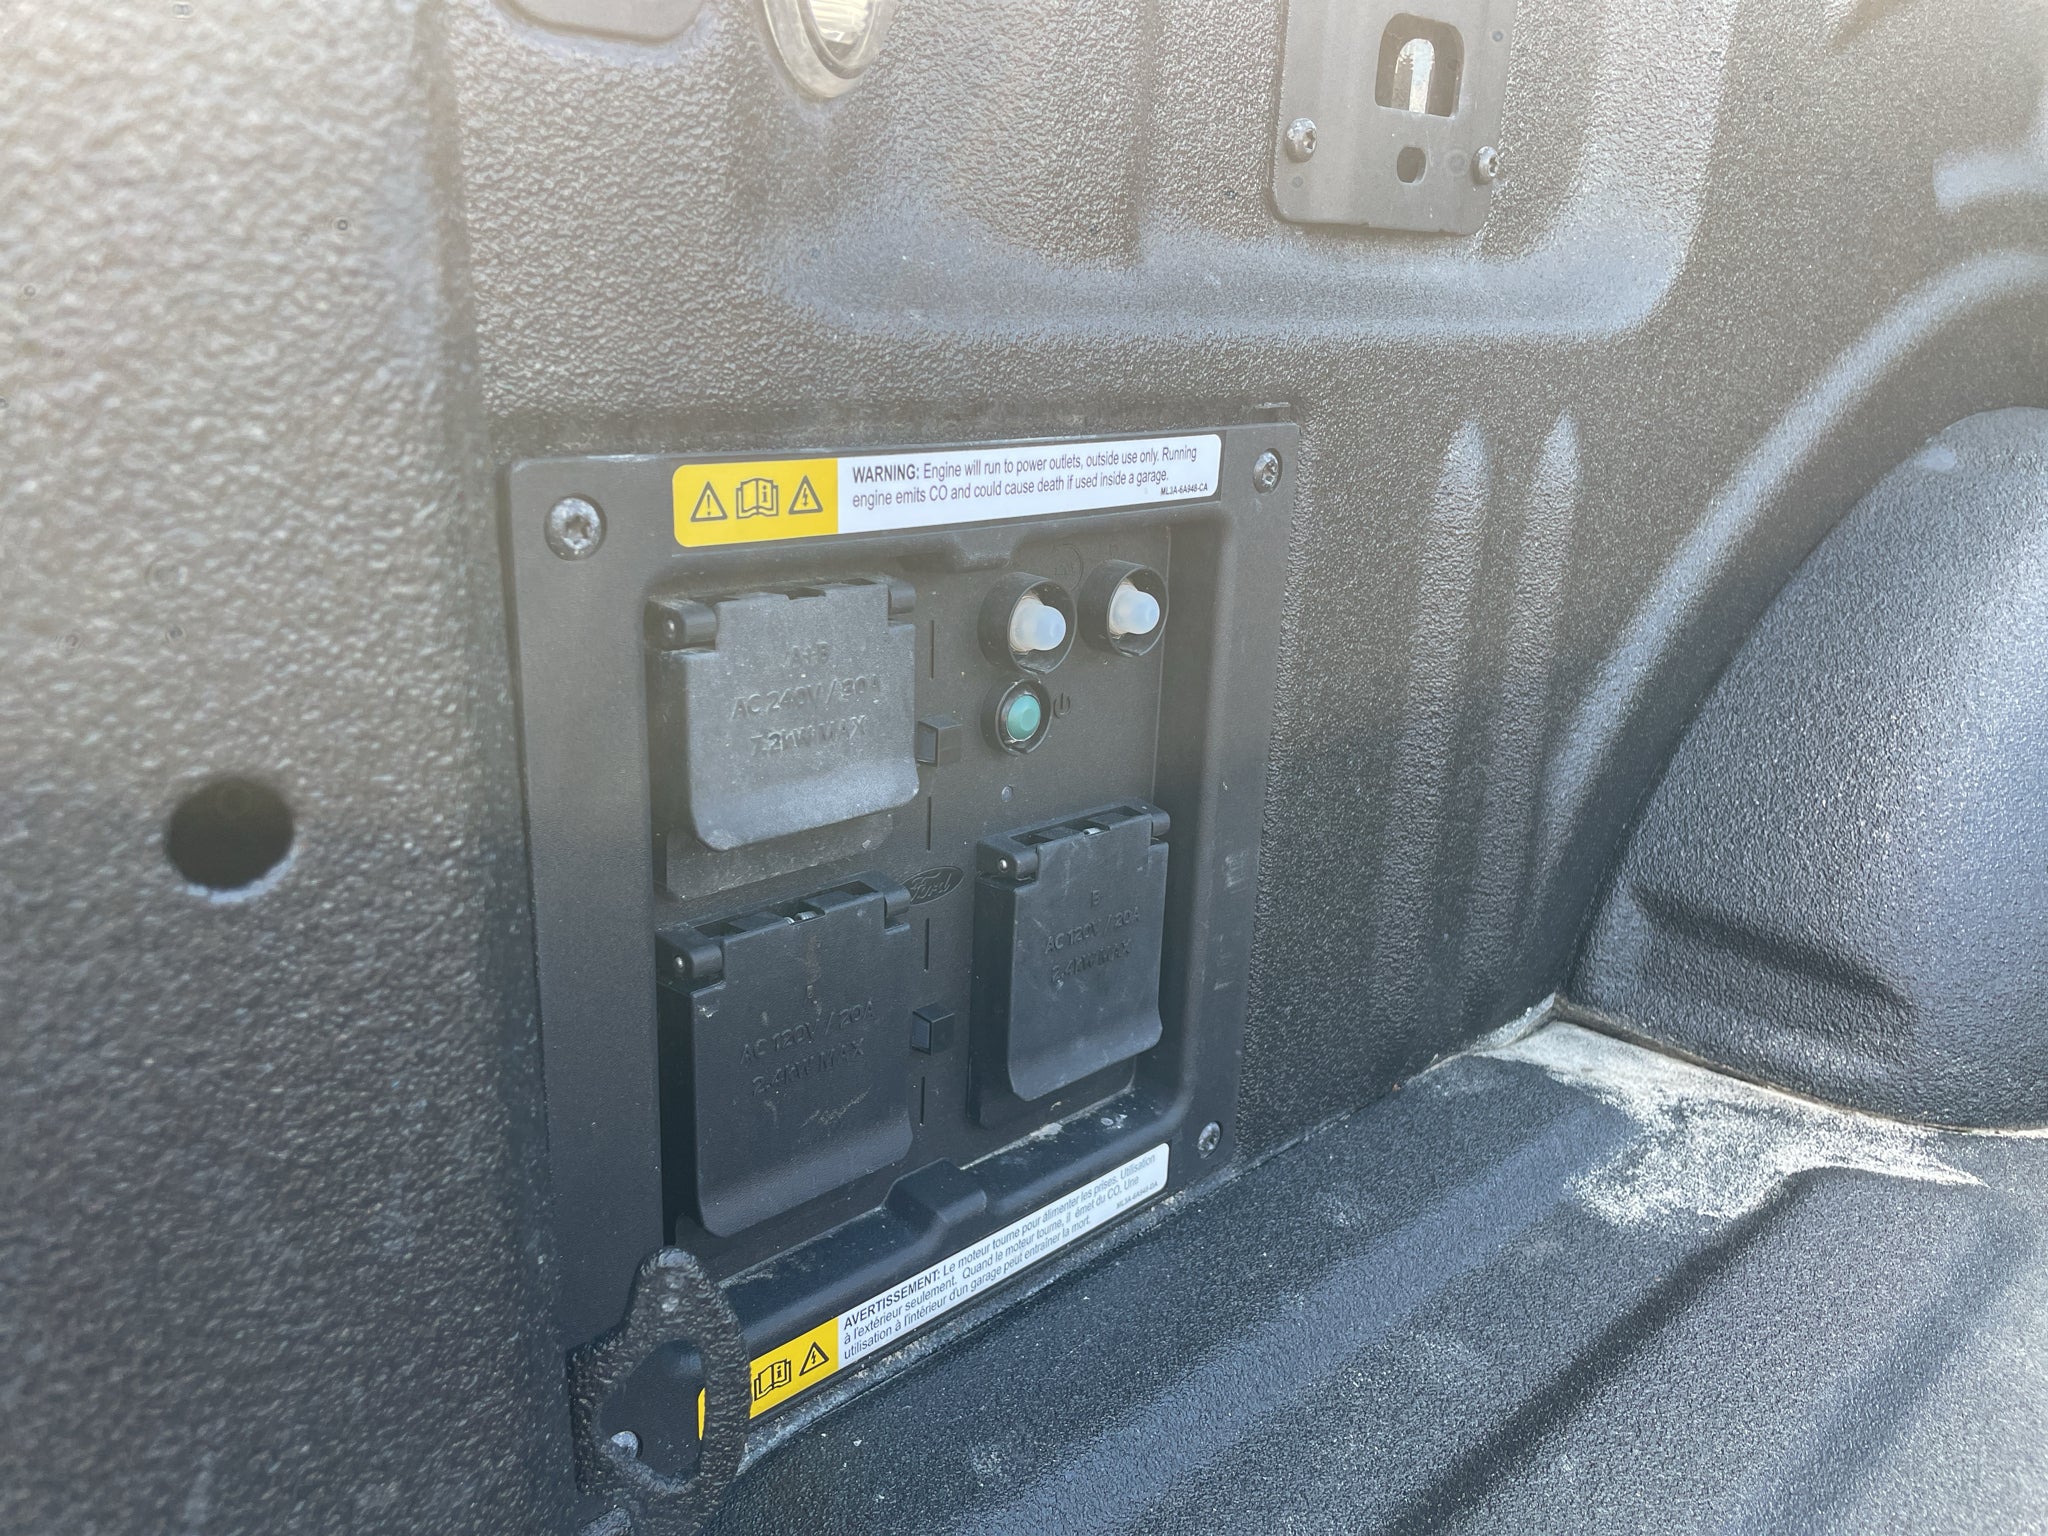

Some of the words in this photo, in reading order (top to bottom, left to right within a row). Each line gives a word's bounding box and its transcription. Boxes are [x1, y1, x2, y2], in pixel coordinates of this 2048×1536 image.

[852, 462, 919, 484] WARNING:
[923, 461, 960, 482] Engine
[964, 459, 980, 476] will
[984, 461, 1000, 474] run
[1004, 459, 1013, 473] to
[1016, 457, 1046, 475] power
[1049, 453, 1082, 471] outlets,
[1086, 450, 1118, 467] outside
[1121, 452, 1137, 464] use
[1139, 448, 1158, 465] only.
[1162, 445, 1196, 464] Running
[852, 489, 891, 511] engine
[896, 486, 925, 504] emits
[929, 484, 947, 501] CO
[951, 483, 970, 499] and
[974, 480, 1001, 497] could
[1004, 481, 1033, 494] cause
[1037, 475, 1063, 492] death
[1067, 475, 1072, 489] if
[1075, 473, 1097, 488] used
[1100, 470, 1125, 486] inside
[1129, 473, 1133, 484] a
[1136, 470, 1168, 486] garage.
[844, 1268, 939, 1330] AVERTISSEMENT:
[943, 1259, 955, 1276] Le
[958, 1242, 989, 1268] moteur
[993, 1226, 1019, 1249] tourne
[1021, 1216, 1039, 1236] pour
[1042, 1194, 1078, 1222] alimenter
[1080, 1187, 1091, 1201] les
[1094, 1173, 1117, 1196] prises.
[1120, 1152, 1155, 1179] Utilisation
[844, 1330, 850, 1345] à
[854, 1302, 901, 1339] l'extérieur
[905, 1273, 956, 1312] seulement.
[963, 1253, 992, 1280] Quand
[995, 1248, 1002, 1262] le
[1005, 1231, 1034, 1256] moteur
[1066, 1211, 1070, 1223] il
[1075, 1198, 1094, 1218] émet
[1096, 1191, 1105, 1206] du
[1124, 1173, 1138, 1191] Une
[844, 1323, 891, 1360] utilisation
[895, 1318, 901, 1332] à
[904, 1293, 946, 1326] l'intérieur
[949, 1281, 967, 1301] d'un
[971, 1265, 1000, 1291] garage
[1003, 1252, 1022, 1273] peut
[1024, 1230, 1059, 1260] entraîner
[1062, 1225, 1069, 1237] la
